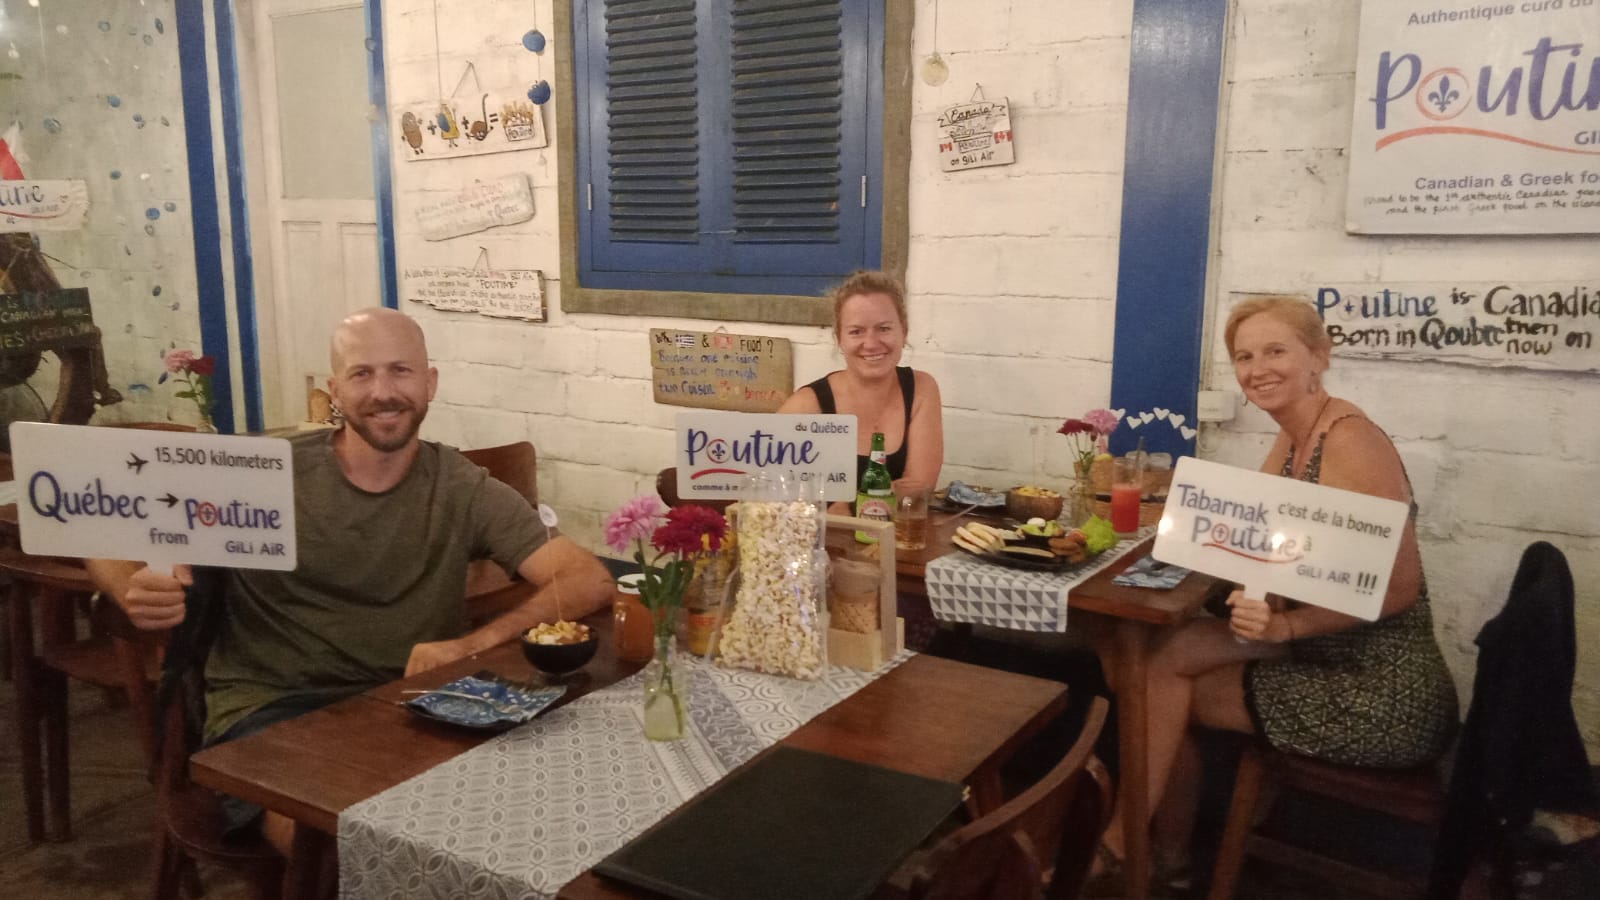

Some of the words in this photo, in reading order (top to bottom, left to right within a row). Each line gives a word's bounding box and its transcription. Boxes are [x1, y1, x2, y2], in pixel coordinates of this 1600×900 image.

[1407, 5, 1514, 26] Authentique
[1415, 174, 1495, 191] Canadian
[1501, 174, 1514, 187] &
[1519, 172, 1574, 187] Greek
[1580, 170, 1600, 184] fo
[1327, 325, 1390, 347] Born
[1396, 325, 1416, 348] in
[1565, 331, 1592, 349] on
[1506, 338, 1553, 356] now
[795, 424, 807, 432] du
[810, 421, 849, 434] Québec
[154, 446, 207, 465] 15,500
[210, 449, 284, 471] kilometers
[28, 470, 149, 524] Québec
[692, 484, 722, 492] comme
[1177, 483, 1270, 526] Tabarnak
[1277, 502, 1309, 521] c'est
[1311, 507, 1329, 523] de
[1331, 510, 1344, 528] la
[1346, 513, 1393, 539] bonne
[149, 527, 189, 546] from
[1303, 535, 1313, 552] à
[1355, 571, 1379, 596] !!!
